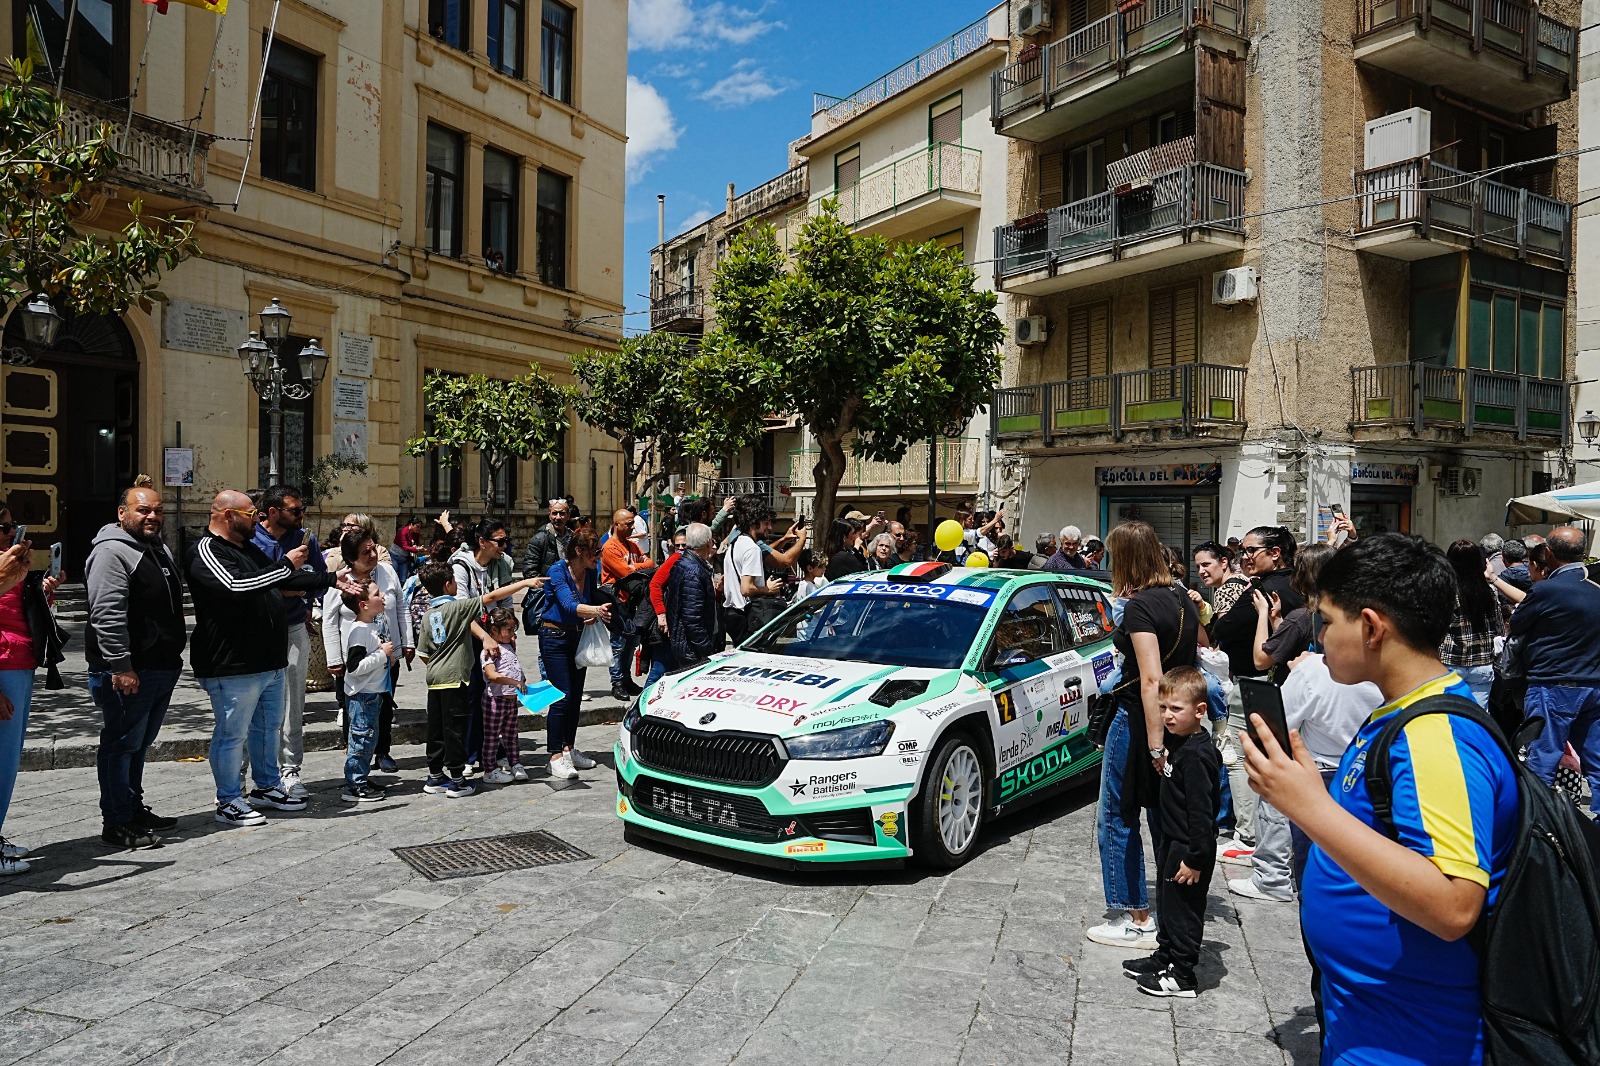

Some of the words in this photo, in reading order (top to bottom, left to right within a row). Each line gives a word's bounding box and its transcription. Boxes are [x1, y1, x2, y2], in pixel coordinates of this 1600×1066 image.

[1102, 470, 1146, 483] EDICOLA
[1149, 471, 1169, 481] DEL
[1381, 470, 1394, 480] DEL
[857, 582, 946, 596] sparco
[429, 611, 447, 644] 8
[706, 665, 842, 689] ENNEBI
[697, 687, 807, 712] BIGonDRY
[1000, 693, 1012, 722] 2
[898, 741, 918, 751] OMP
[902, 756, 919, 764] BELL
[809, 771, 858, 786] Rangers
[813, 781, 856, 795] Battistolli
[652, 786, 740, 828] DELTA
[788, 843, 824, 853] PIRELLI
